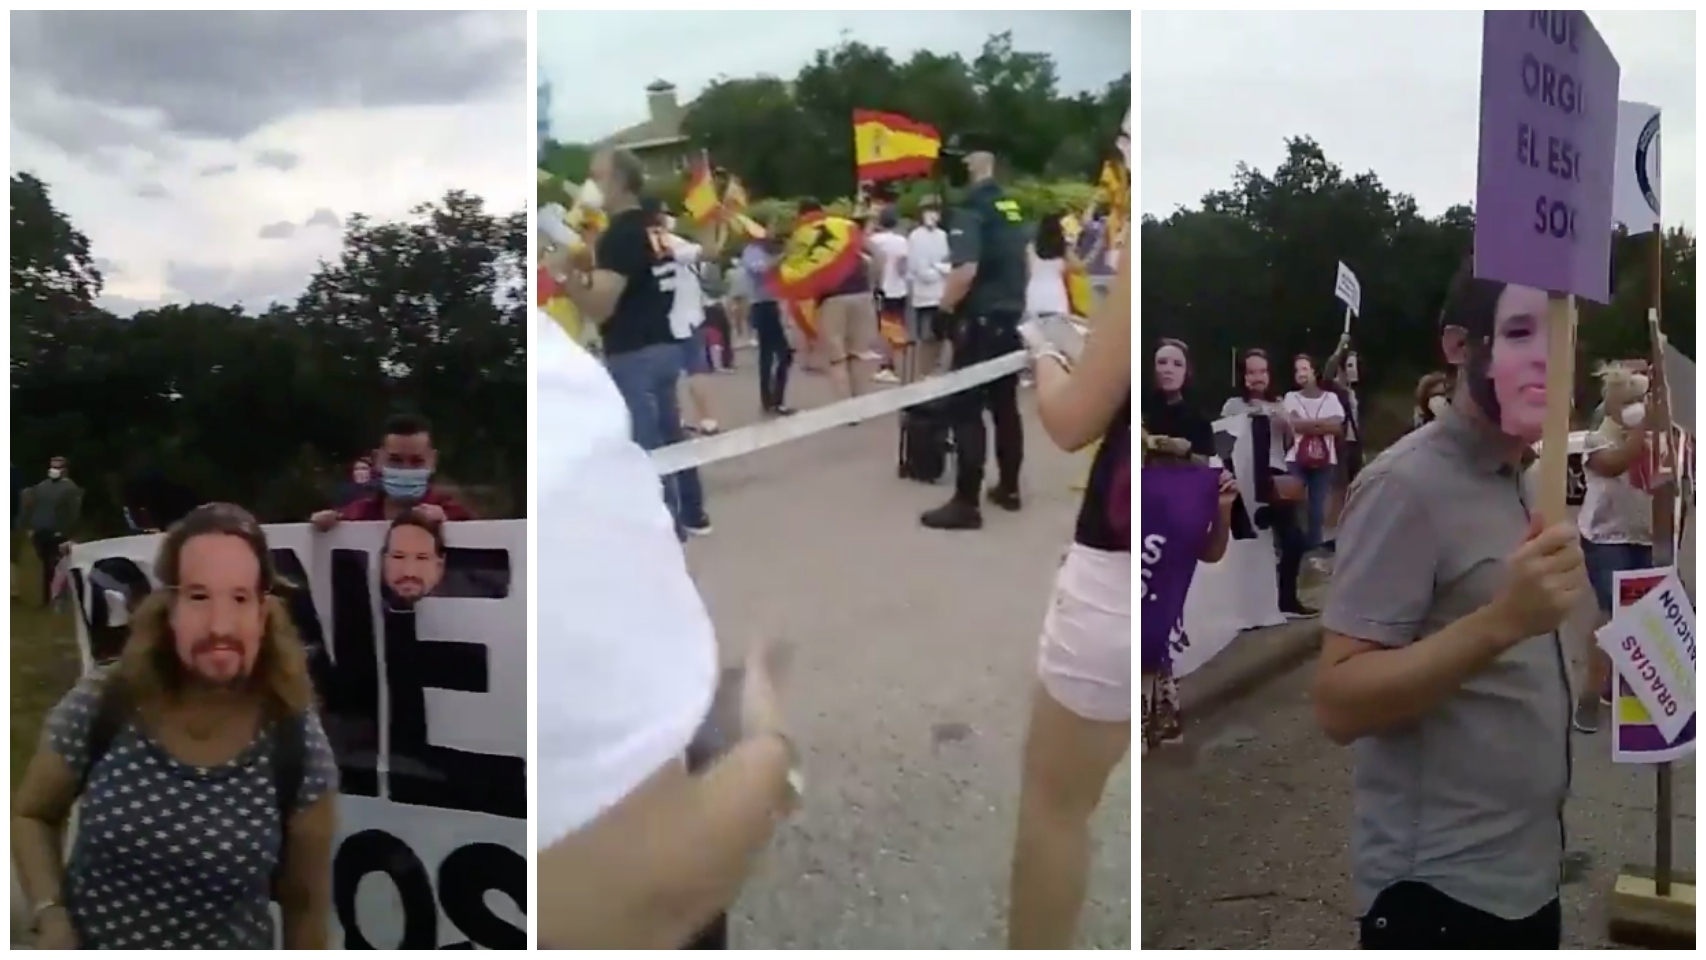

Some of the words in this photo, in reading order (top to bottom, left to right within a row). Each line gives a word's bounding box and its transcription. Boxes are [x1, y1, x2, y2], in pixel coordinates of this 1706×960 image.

[1517, 122, 1540, 169] EL
[1658, 589, 1697, 672] ALICIÓN
[1621, 635, 1678, 717] GRACIAS
